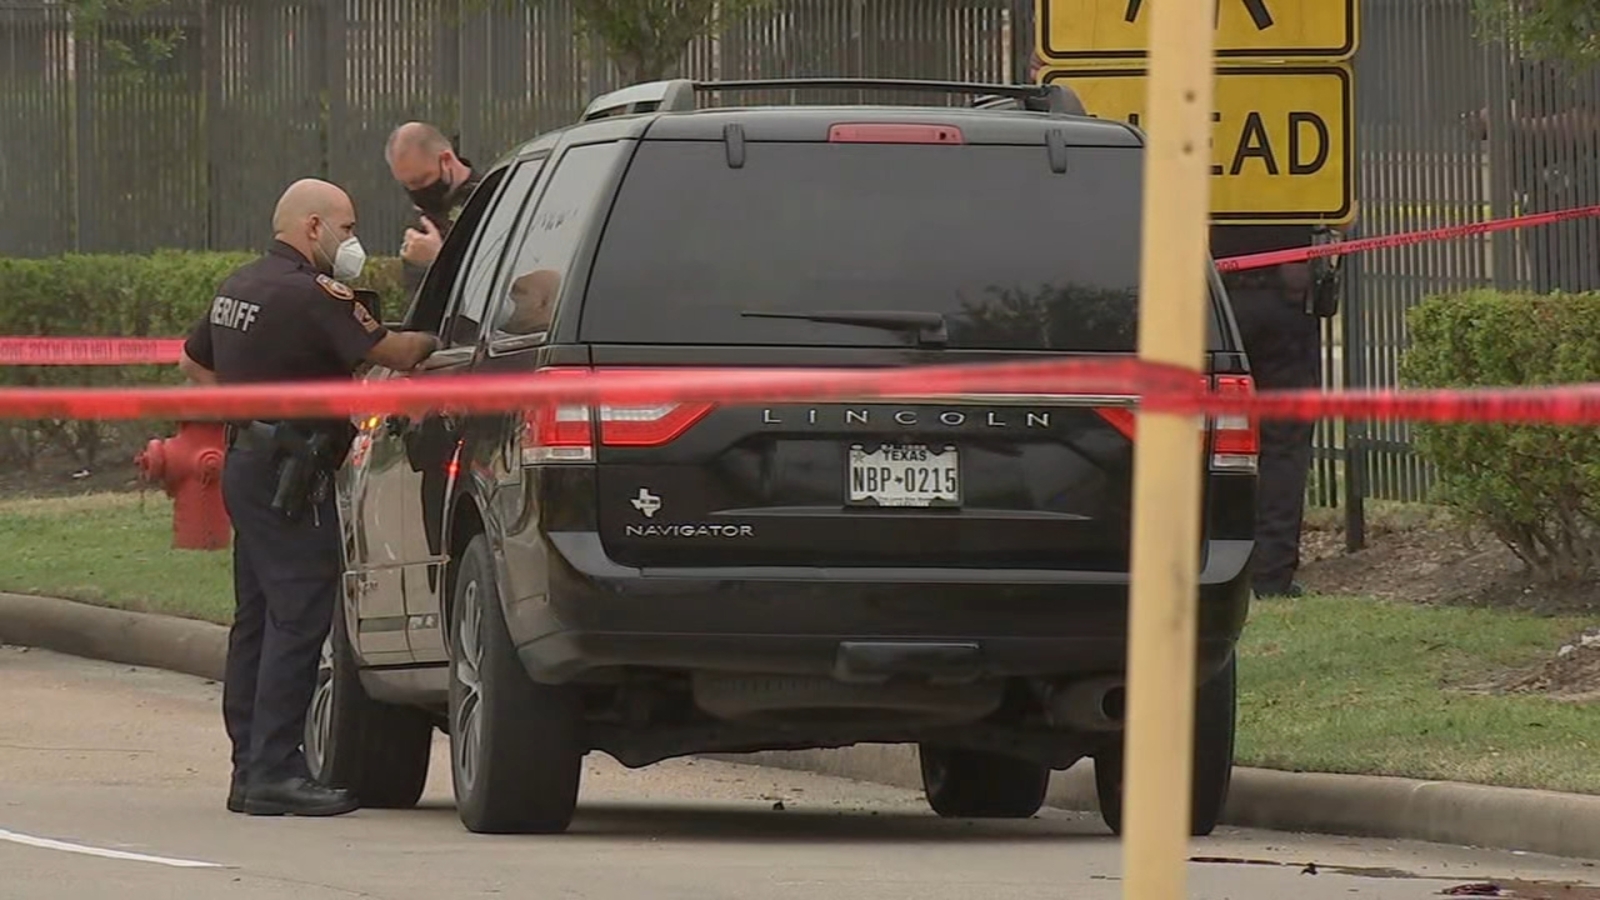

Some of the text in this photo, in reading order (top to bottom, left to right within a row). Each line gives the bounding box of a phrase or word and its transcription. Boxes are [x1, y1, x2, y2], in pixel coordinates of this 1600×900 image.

[764, 409, 1049, 427] LINCOLN
[882, 449, 928, 462] TEXAS
[625, 525, 754, 537] NAVIGATOR
